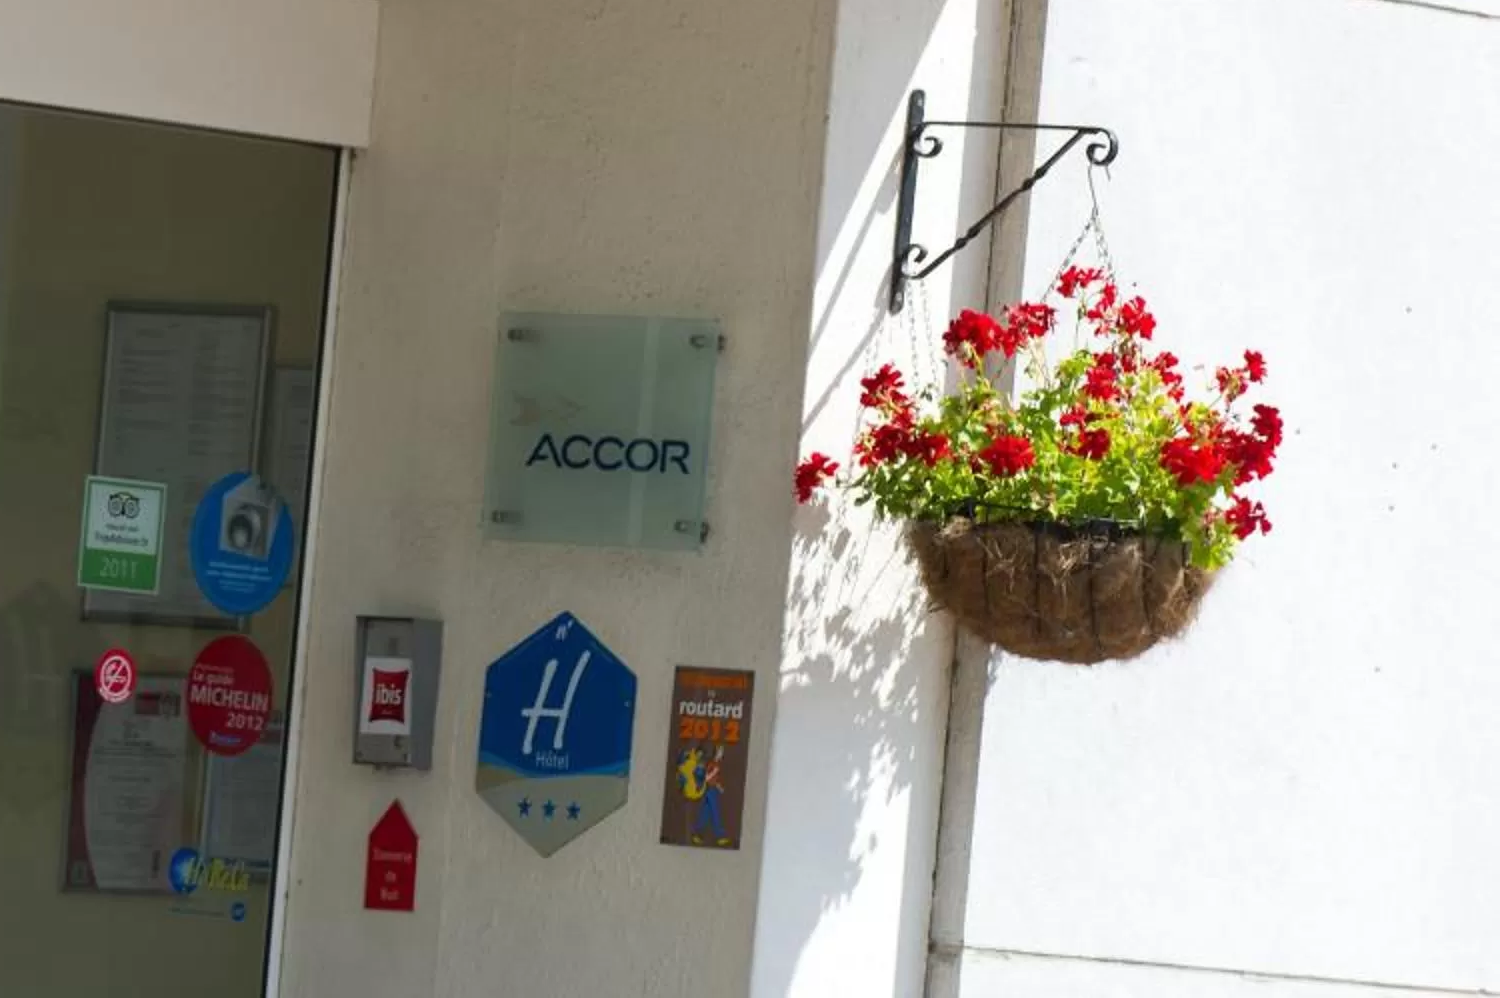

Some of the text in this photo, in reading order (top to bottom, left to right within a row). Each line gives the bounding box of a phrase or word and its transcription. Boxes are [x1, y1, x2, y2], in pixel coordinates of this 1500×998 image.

[525, 433, 690, 475] ACCOR
[191, 684, 269, 713] MICHELIN
[375, 682, 402, 705] ibis
[521, 650, 591, 754] H
[225, 711, 264, 731] 2012
[680, 699, 743, 720] routard
[679, 716, 740, 743] 2012
